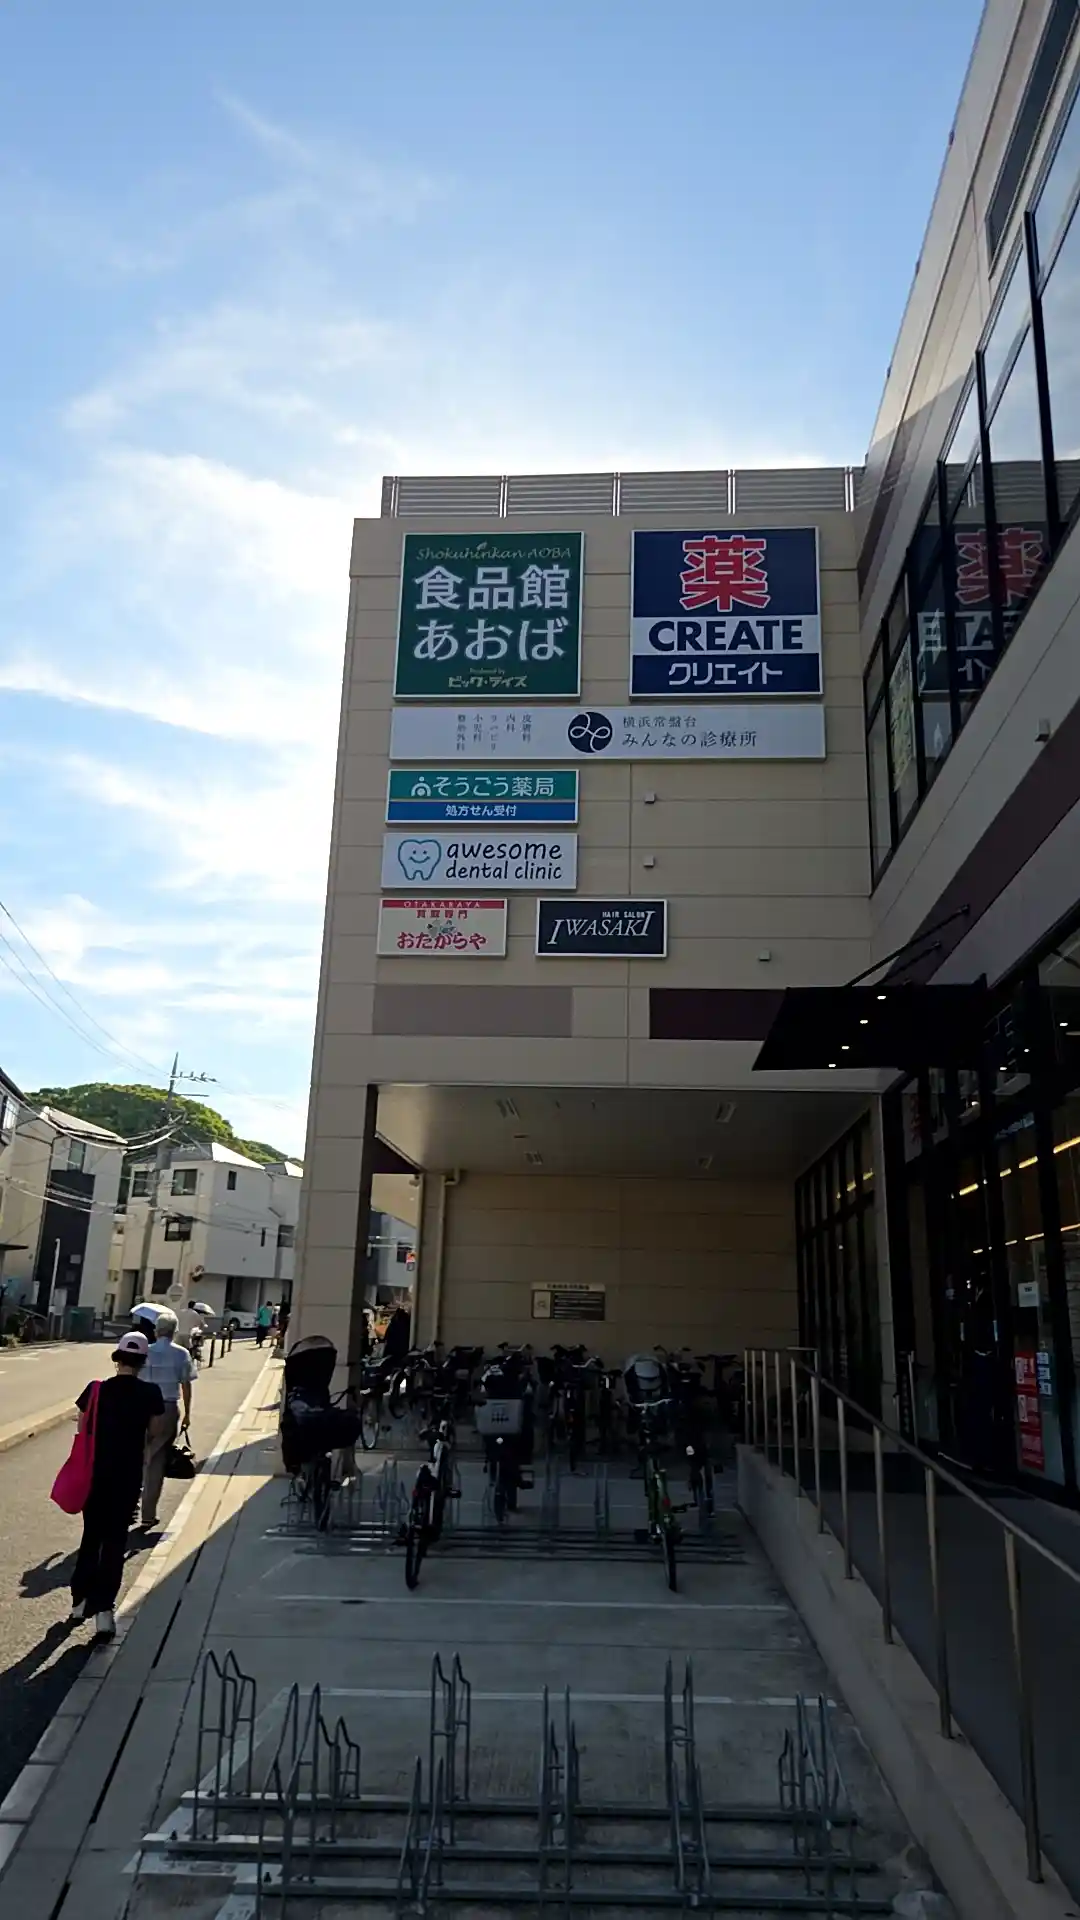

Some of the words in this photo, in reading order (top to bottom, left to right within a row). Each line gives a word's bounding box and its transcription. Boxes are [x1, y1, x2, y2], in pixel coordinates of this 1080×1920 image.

[416, 545, 523, 560] Shokuhinkan
[527, 547, 572, 559] AOBA
[678, 534, 772, 612] 薬
[413, 563, 570, 611] 食品館
[413, 616, 570, 661] あおば
[648, 619, 803, 652] CREATE
[668, 661, 784, 686] クリエイト
[622, 731, 757, 748] みんなの診療所
[433, 776, 554, 797] そうごう薬局
[445, 805, 517, 817] 処方せん受付
[446, 842, 563, 860] awesome
[445, 860, 509, 880] dental
[514, 861, 562, 880] clinic
[547, 910, 656, 945] IWASAKI
